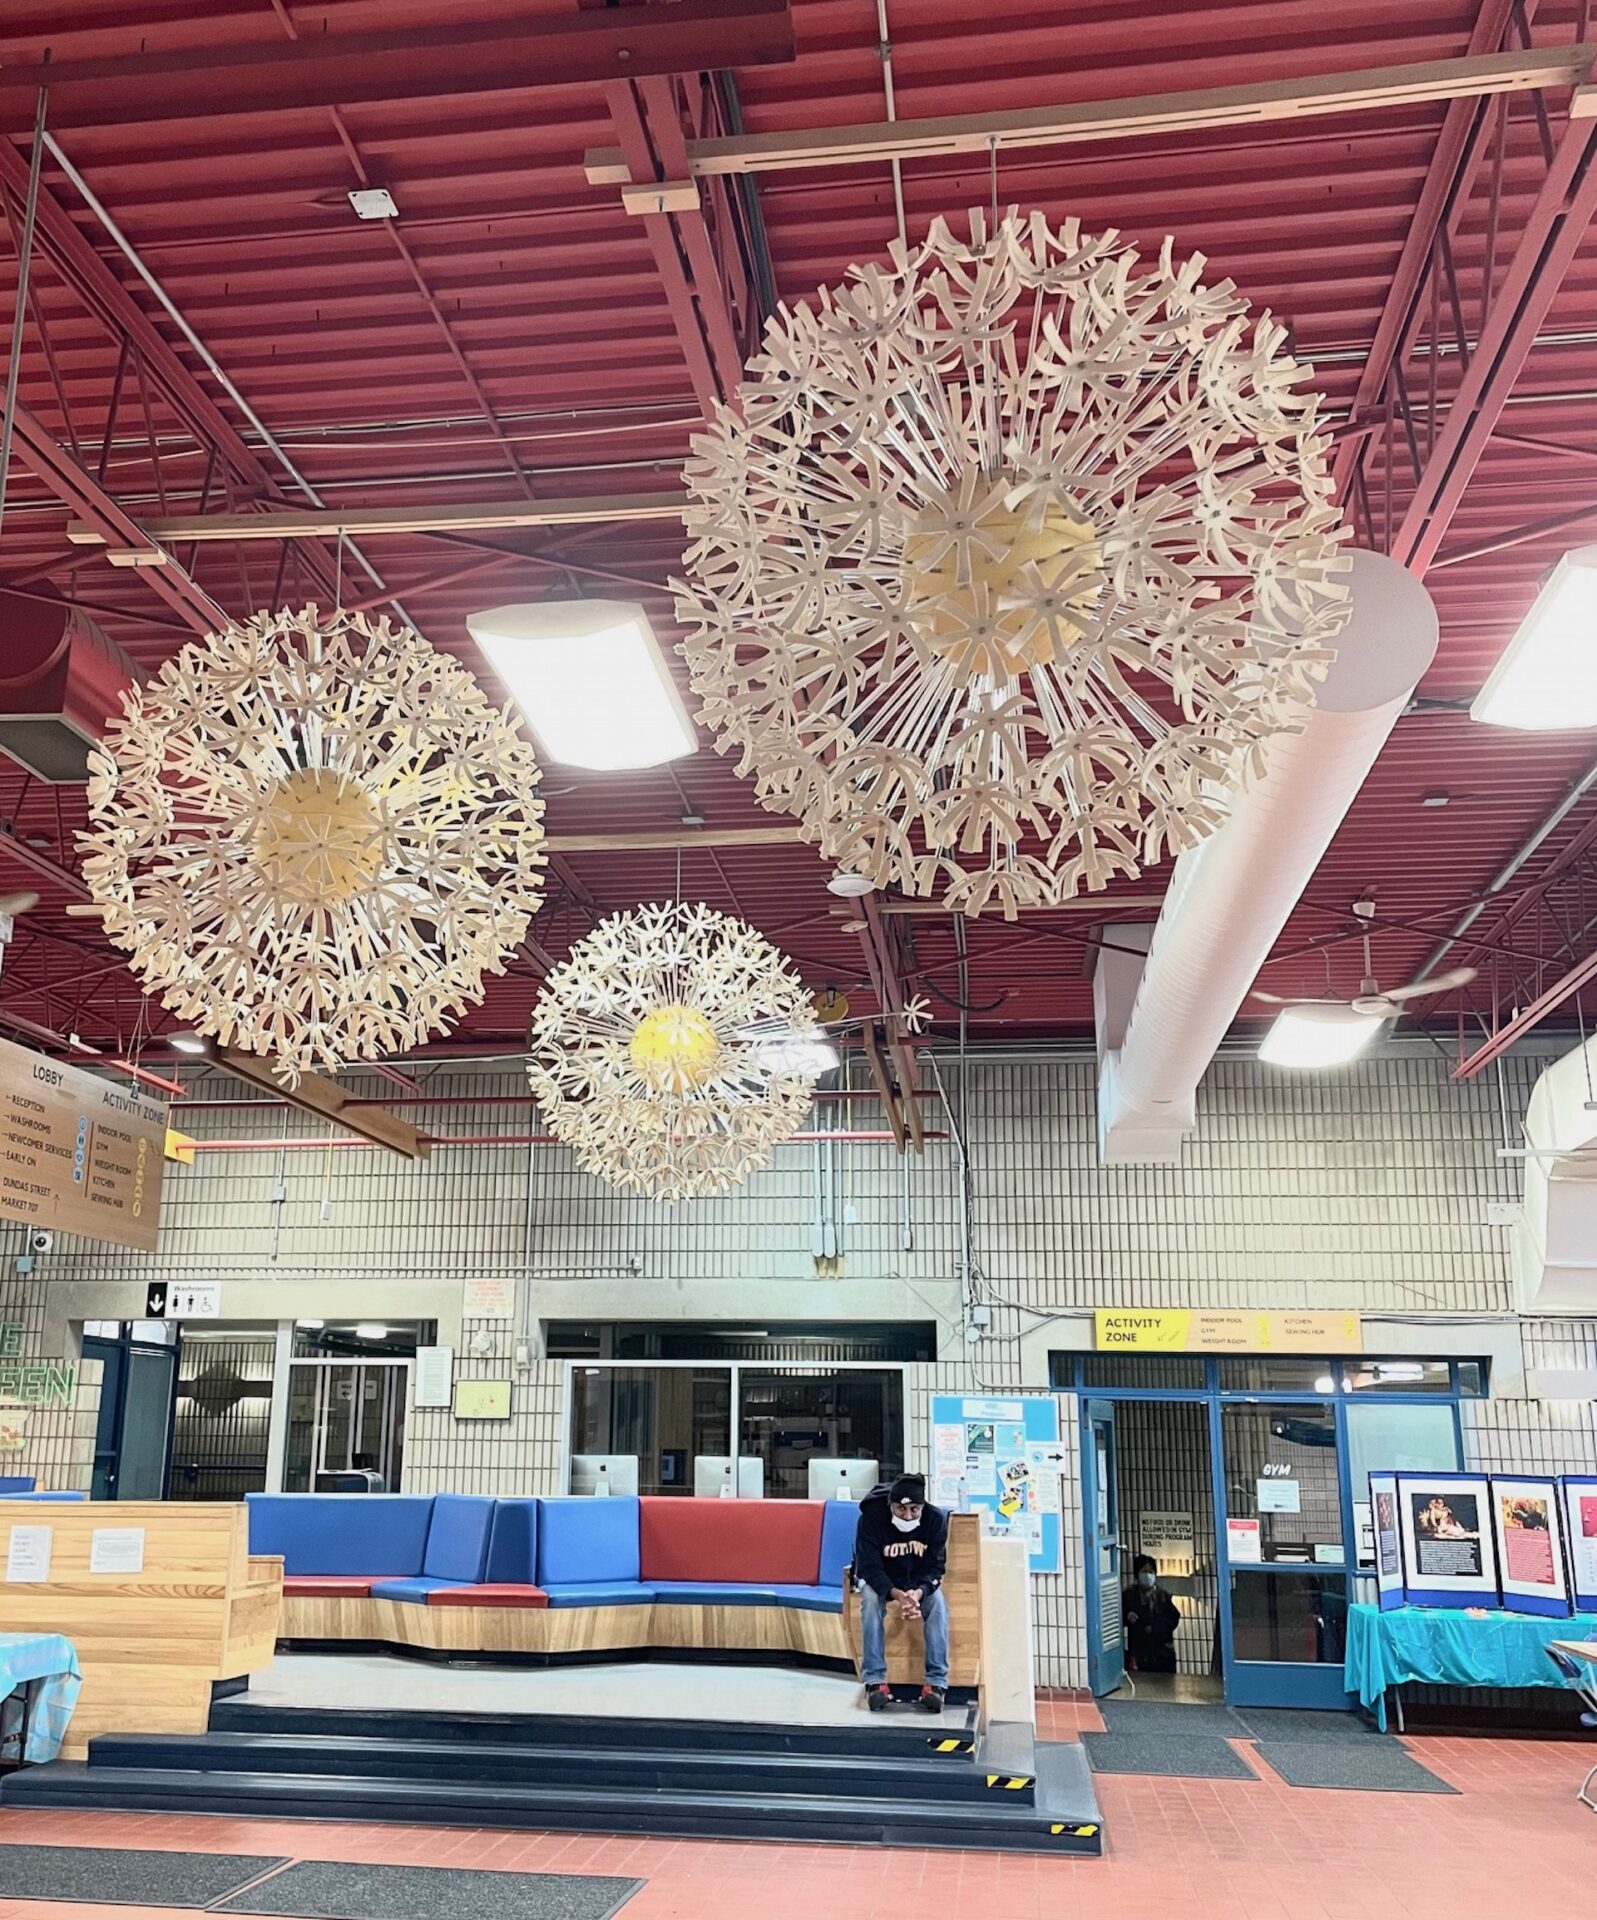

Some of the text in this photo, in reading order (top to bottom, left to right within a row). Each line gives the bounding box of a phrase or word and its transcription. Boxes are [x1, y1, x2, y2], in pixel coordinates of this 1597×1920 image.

[33, 1064, 64, 1087] LOBBY
[12, 1094, 45, 1114] RECEPTION
[102, 1091, 165, 1125] ACTIVITY ZONE
[10, 1113, 52, 1134] WASHROOMS
[97, 1124, 132, 1143] INDOOR POOL
[8, 1132, 72, 1159] NEWCOMER SERVICES
[95, 1141, 109, 1152] GYM
[6, 1150, 37, 1167] EARLY ON
[94, 1159, 132, 1175] WEIGHT ROOM
[3, 1177, 51, 1197] DUNDAS STREET
[92, 1176, 116, 1189] KITCHEN
[1, 1195, 39, 1213] MARKET 707
[1105, 1318, 1162, 1328] ACTIVITY
[1105, 1332, 1137, 1342] ZONE
[1262, 1463, 1292, 1476] GYM
